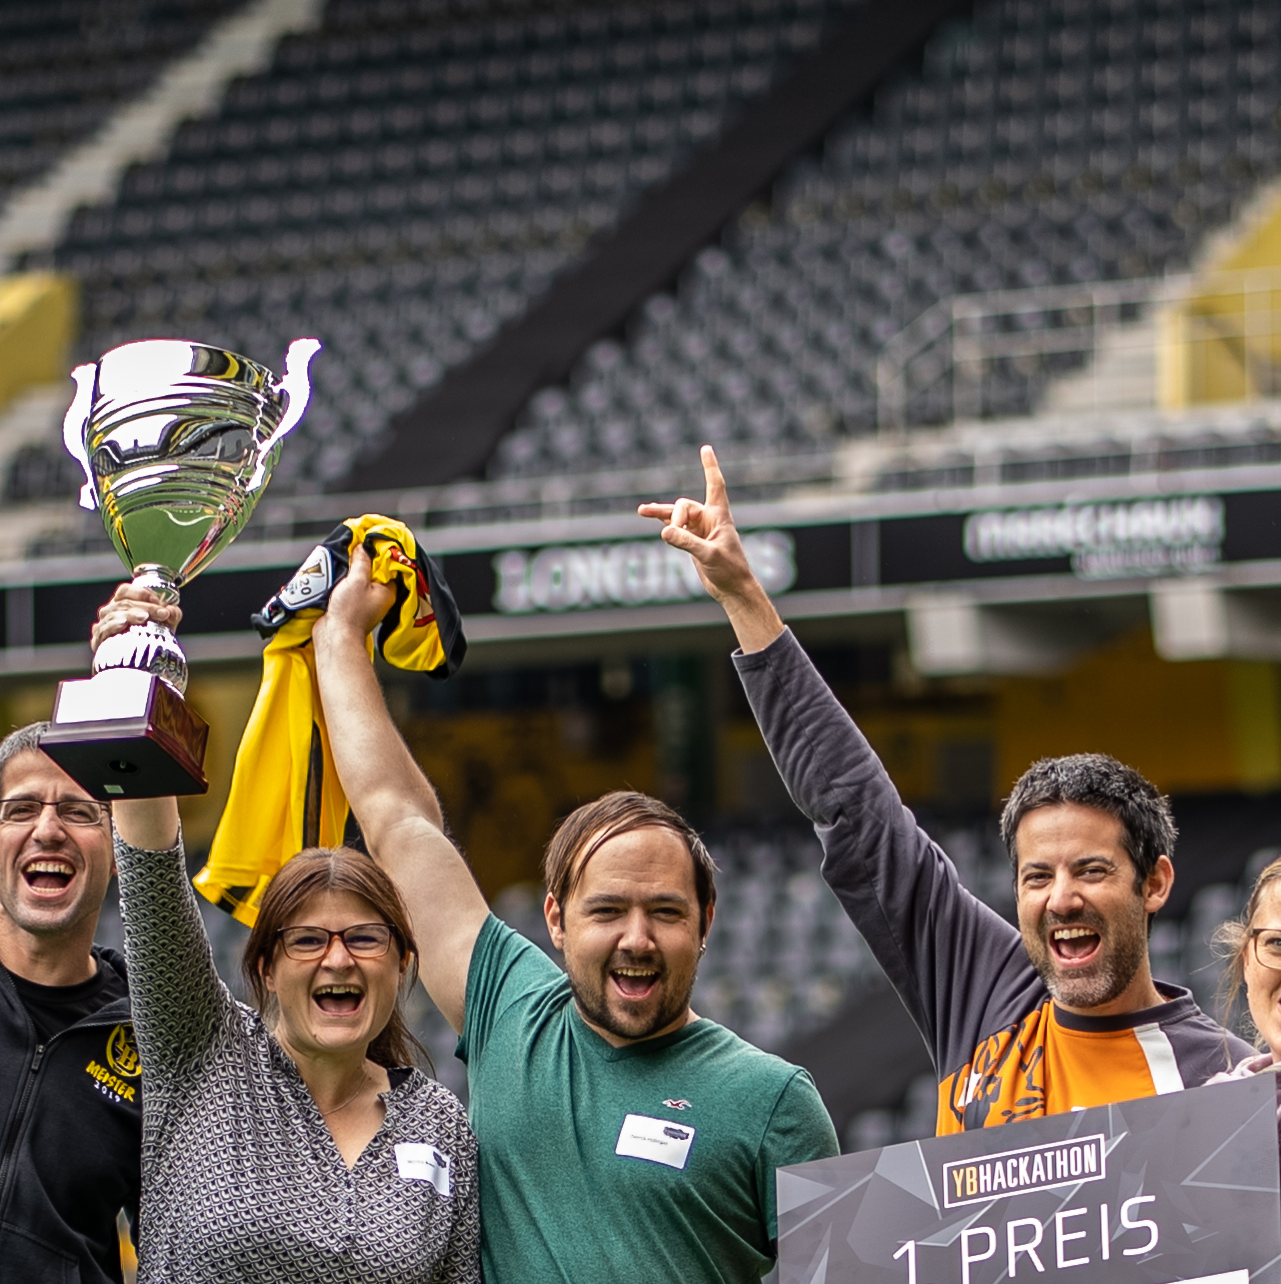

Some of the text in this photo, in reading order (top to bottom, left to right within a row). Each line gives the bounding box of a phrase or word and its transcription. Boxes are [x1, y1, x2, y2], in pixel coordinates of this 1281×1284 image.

[493, 529, 797, 614] LONGINS
[86, 1060, 135, 1102] MEISTER
[93, 1080, 121, 1102] 2019
[952, 1143, 1097, 1198] YBHACKATHON
